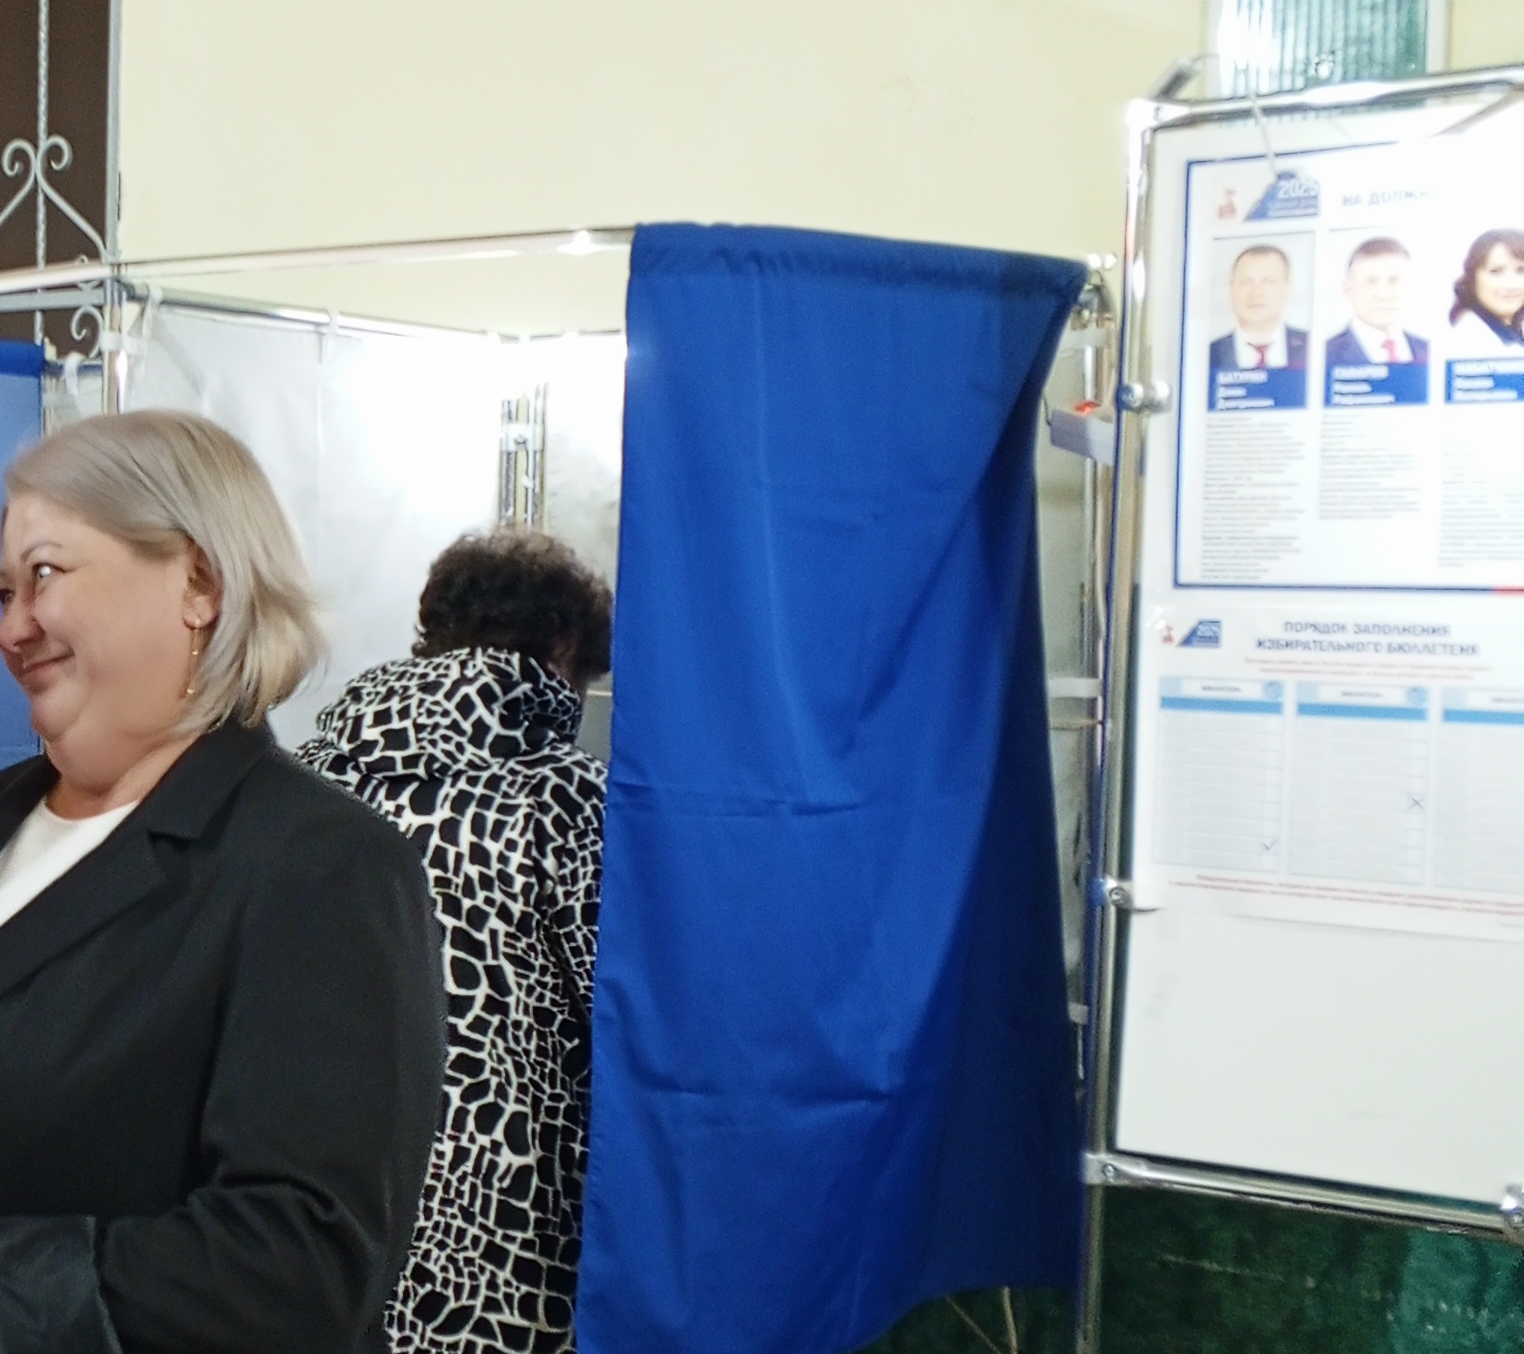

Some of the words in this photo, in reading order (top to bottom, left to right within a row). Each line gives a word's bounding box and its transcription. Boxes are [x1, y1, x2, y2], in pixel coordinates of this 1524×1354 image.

[1279, 179, 1319, 198] 2025
[1284, 621, 1348, 635] ПОРЯДОК
[1353, 622, 1451, 637] ЗАПОЛНЕНИЯ
[1257, 637, 1383, 654] ИЗБИРАТЕЛЬНОГО
[1387, 643, 1479, 656] БЮЛЛЕТЕНЯ
